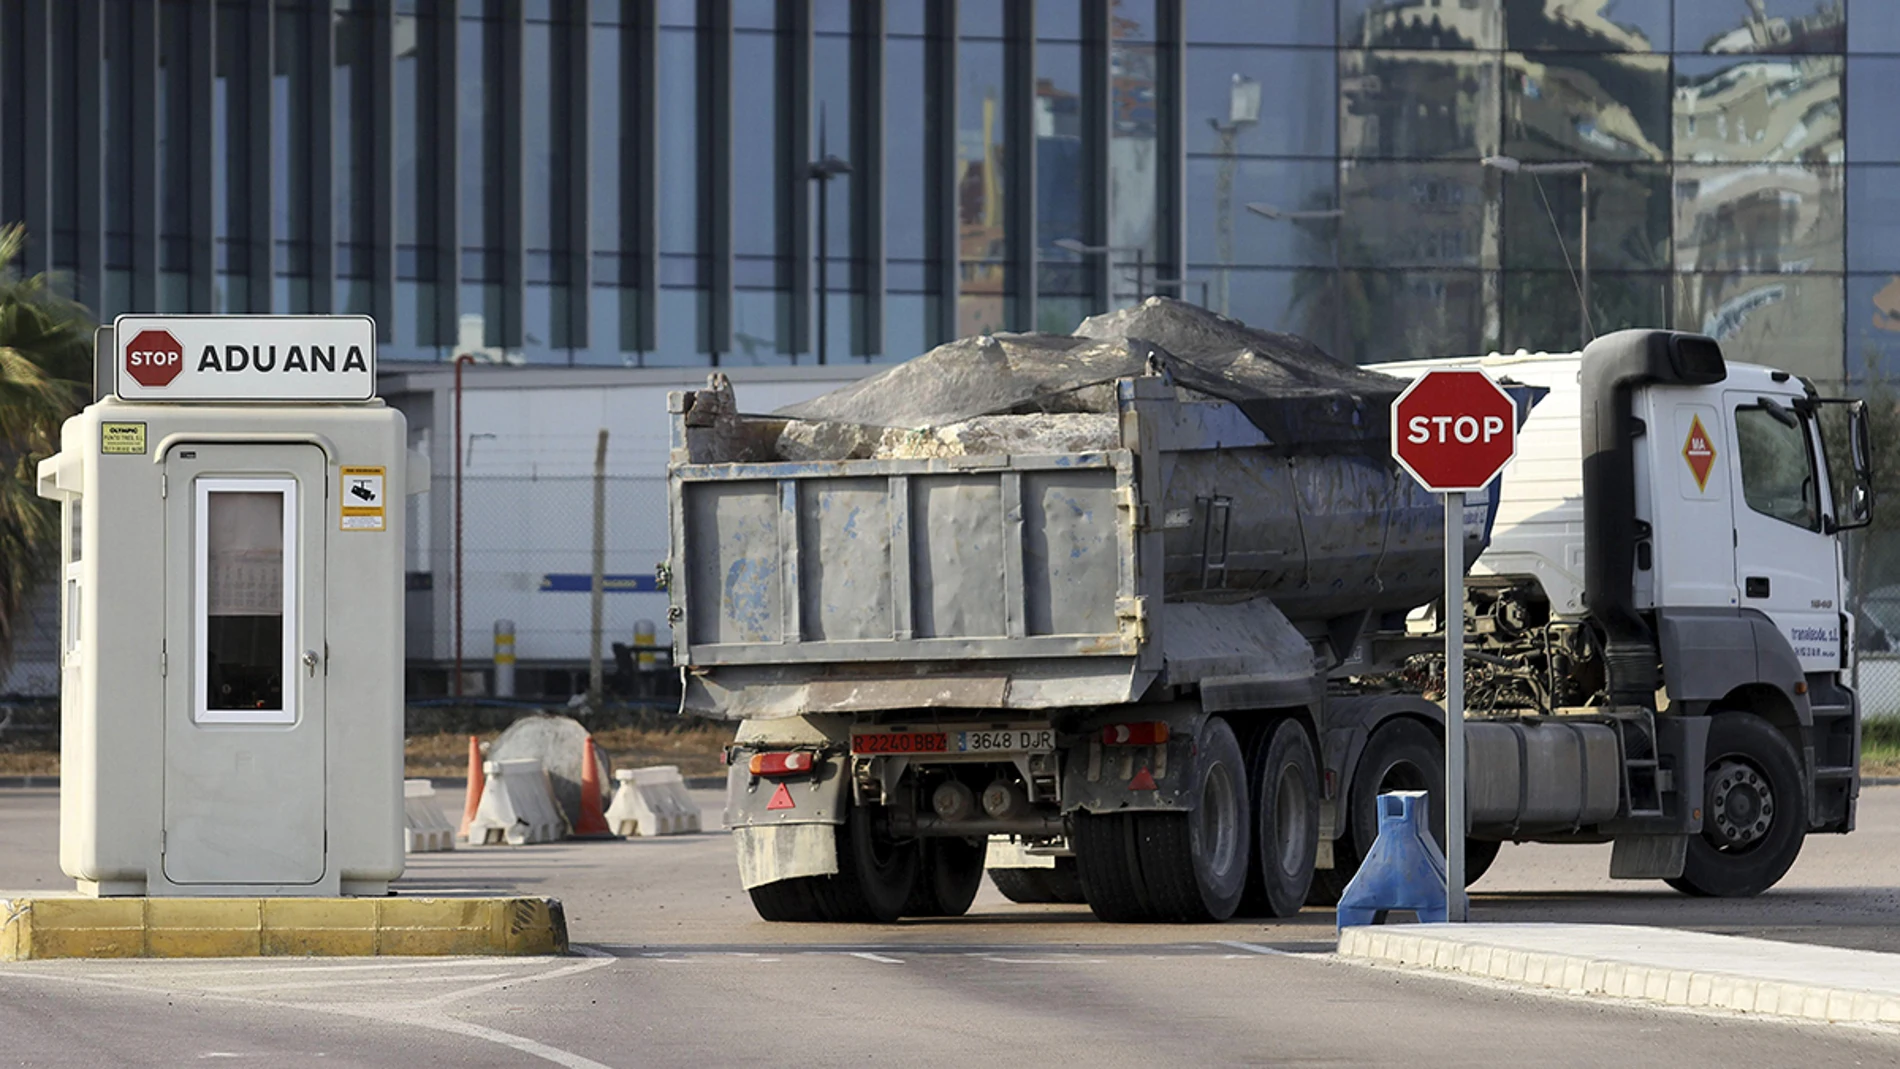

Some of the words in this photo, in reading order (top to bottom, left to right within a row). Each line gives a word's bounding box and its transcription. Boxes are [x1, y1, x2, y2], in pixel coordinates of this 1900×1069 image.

[130, 351, 179, 366] STOP
[197, 345, 368, 372] ADUANA
[1407, 416, 1504, 444] STOP
[853, 736, 864, 751] R
[869, 734, 910, 751] 2240
[971, 732, 1012, 749] 3648
[1020, 732, 1053, 748] DJR
